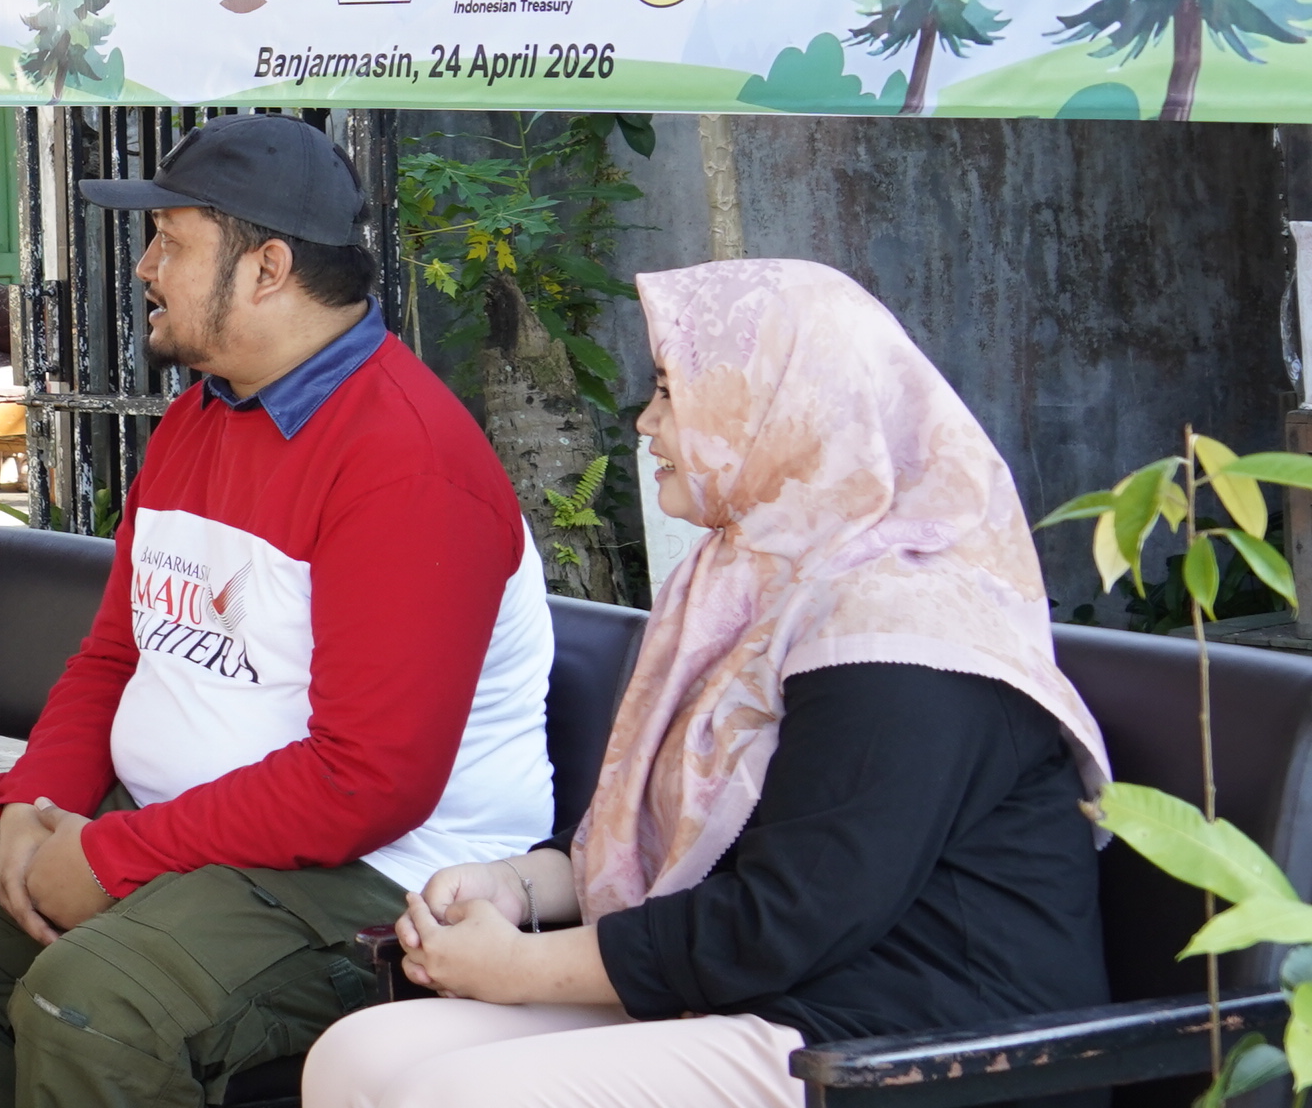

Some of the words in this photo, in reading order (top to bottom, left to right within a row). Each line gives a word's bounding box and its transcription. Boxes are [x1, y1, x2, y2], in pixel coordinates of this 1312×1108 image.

[520, 0, 573, 15] Treasury
[254, 45, 420, 85] Banjarmasin,
[428, 44, 461, 79] 24
[467, 43, 538, 86] April
[544, 43, 615, 79] 2026
[132, 567, 205, 625] MAJU
